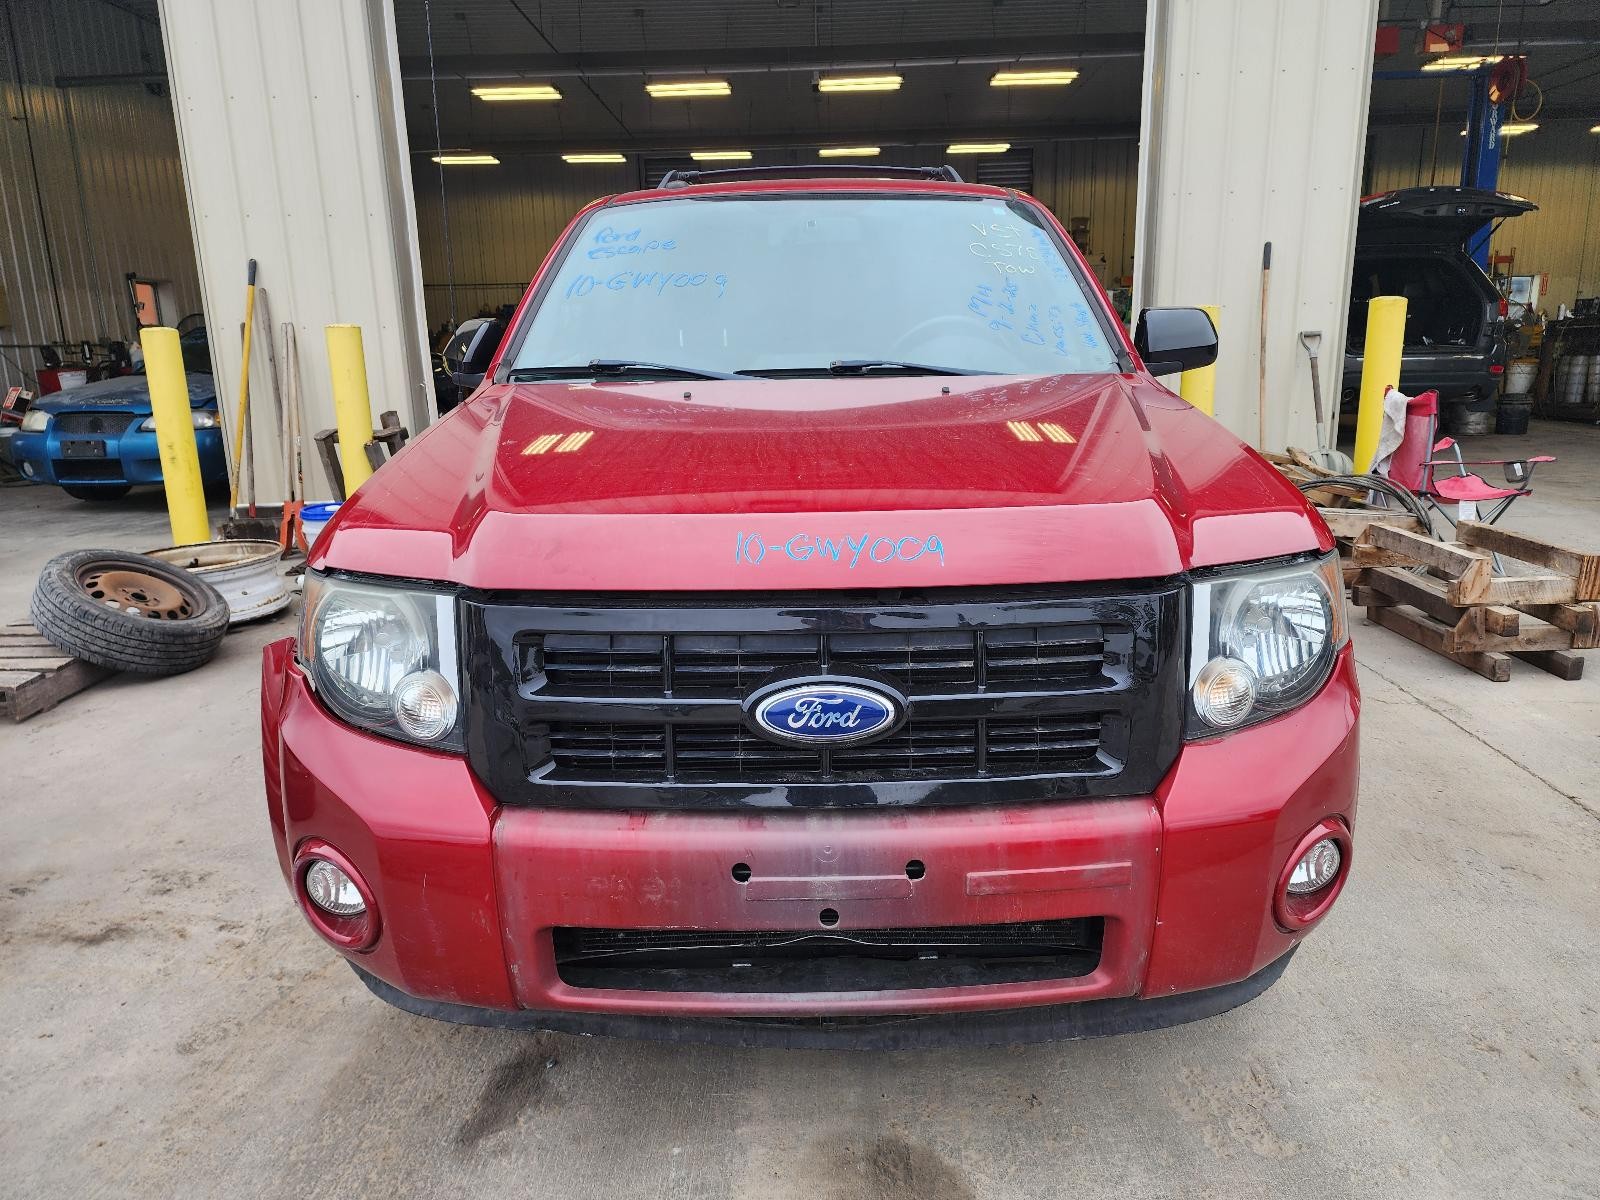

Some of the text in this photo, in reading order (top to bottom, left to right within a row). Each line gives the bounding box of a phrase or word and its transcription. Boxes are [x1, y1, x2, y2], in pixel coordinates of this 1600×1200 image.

[566, 271, 728, 299] 10-GWY009
[735, 531, 945, 568] 10-GWY009
[788, 698, 861, 728] Ford
